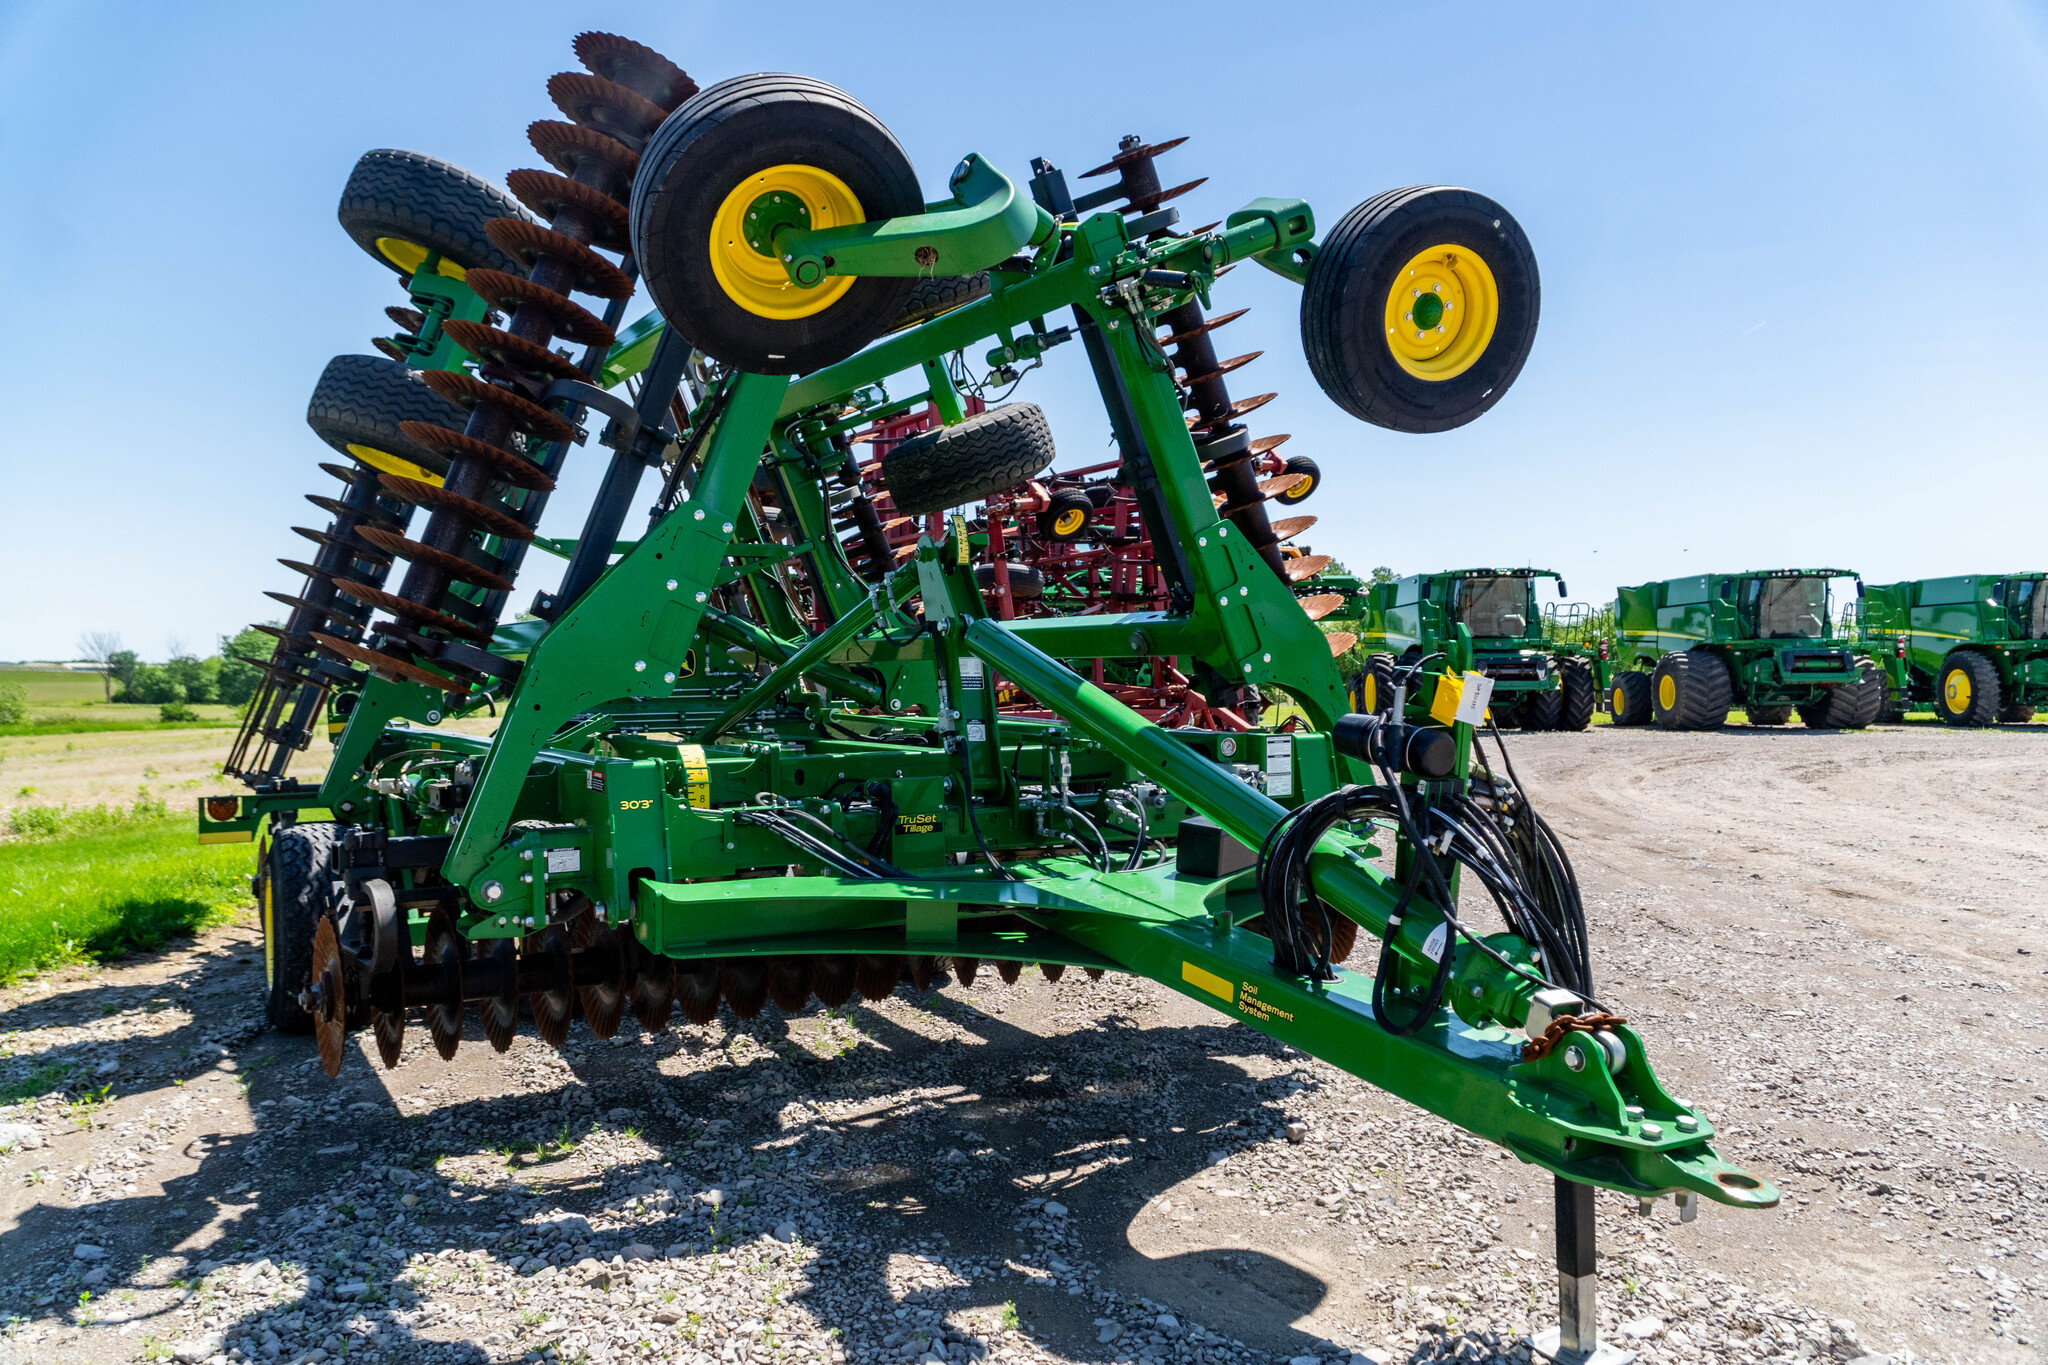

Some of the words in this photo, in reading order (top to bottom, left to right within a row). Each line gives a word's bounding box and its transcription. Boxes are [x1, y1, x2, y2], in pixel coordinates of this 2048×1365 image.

[700, 794, 706, 803] 8
[898, 813, 937, 825] TruSet
[903, 824, 934, 834] Tillage
[1242, 981, 1259, 995] Soil
[1238, 1000, 1270, 1022] System
[1239, 990, 1295, 1023] Management
